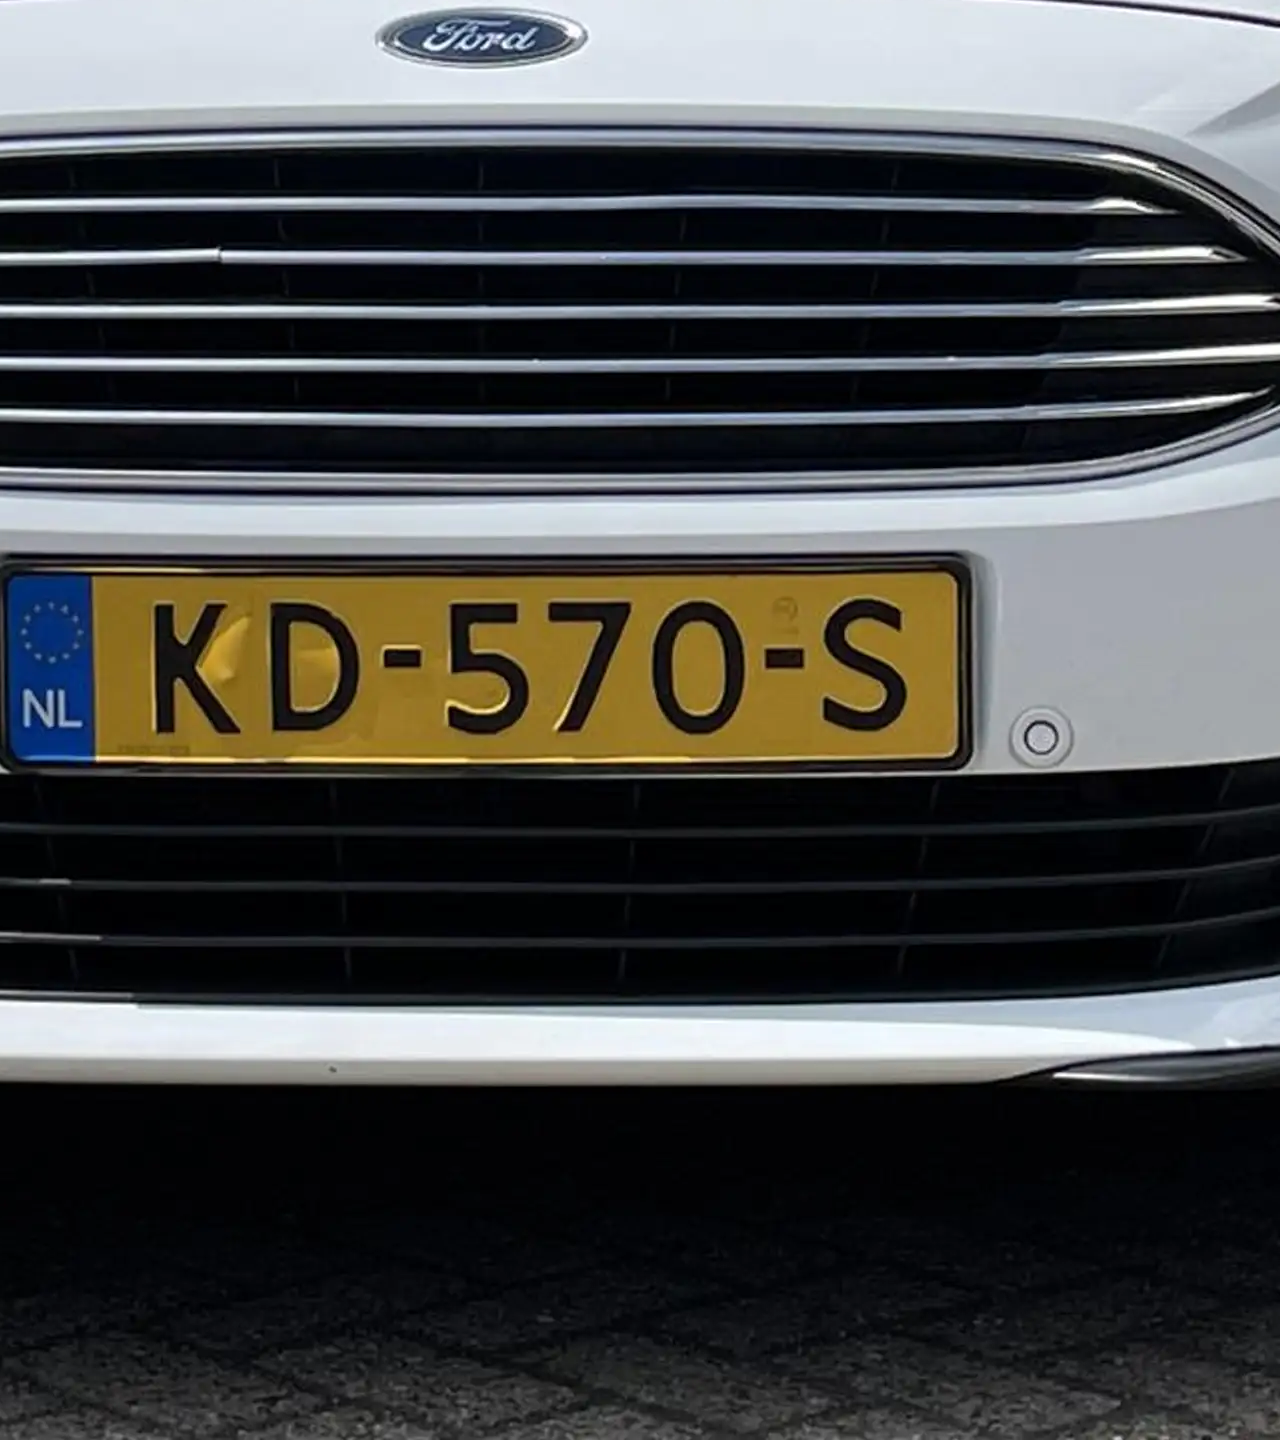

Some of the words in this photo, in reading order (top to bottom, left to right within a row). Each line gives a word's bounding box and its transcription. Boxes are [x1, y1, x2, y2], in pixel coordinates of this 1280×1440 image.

[422, 18, 540, 52] Ford
[152, 599, 908, 736] KD-570-S
[21, 689, 82, 729] NL
